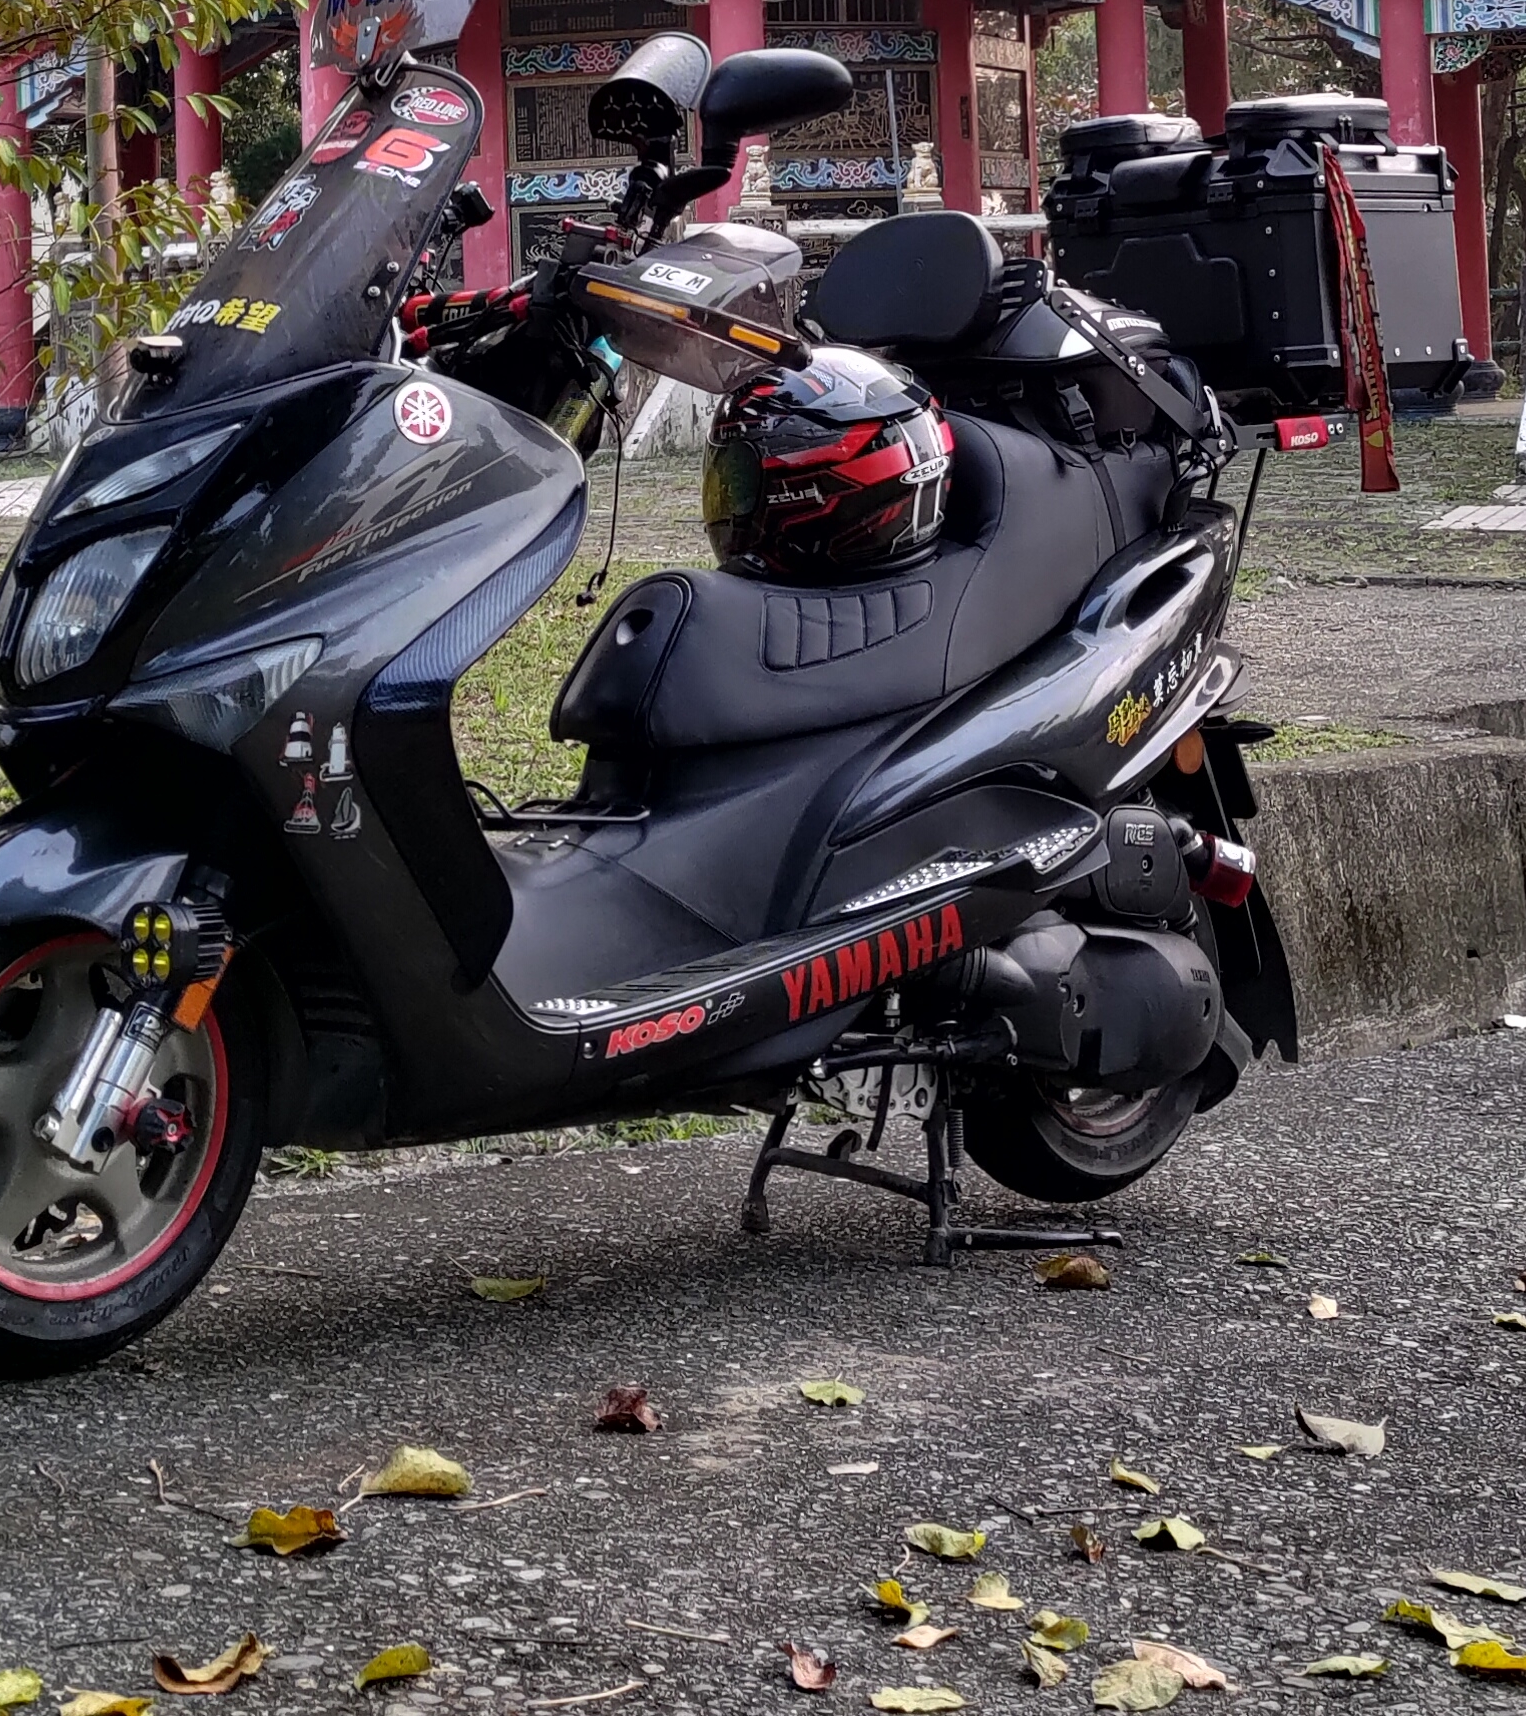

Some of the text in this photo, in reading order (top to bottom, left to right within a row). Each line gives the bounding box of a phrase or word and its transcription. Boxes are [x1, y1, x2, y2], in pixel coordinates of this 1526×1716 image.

[410, 95, 438, 111] RED
[432, 100, 465, 120] LINE
[648, 266, 681, 281] SJC
[1290, 431, 1319, 447] KOSO
[910, 459, 944, 479] ZEUS
[296, 479, 473, 584] Fuel Injection
[782, 903, 964, 1022] YAMAHA
[605, 1005, 707, 1060] KOSO
